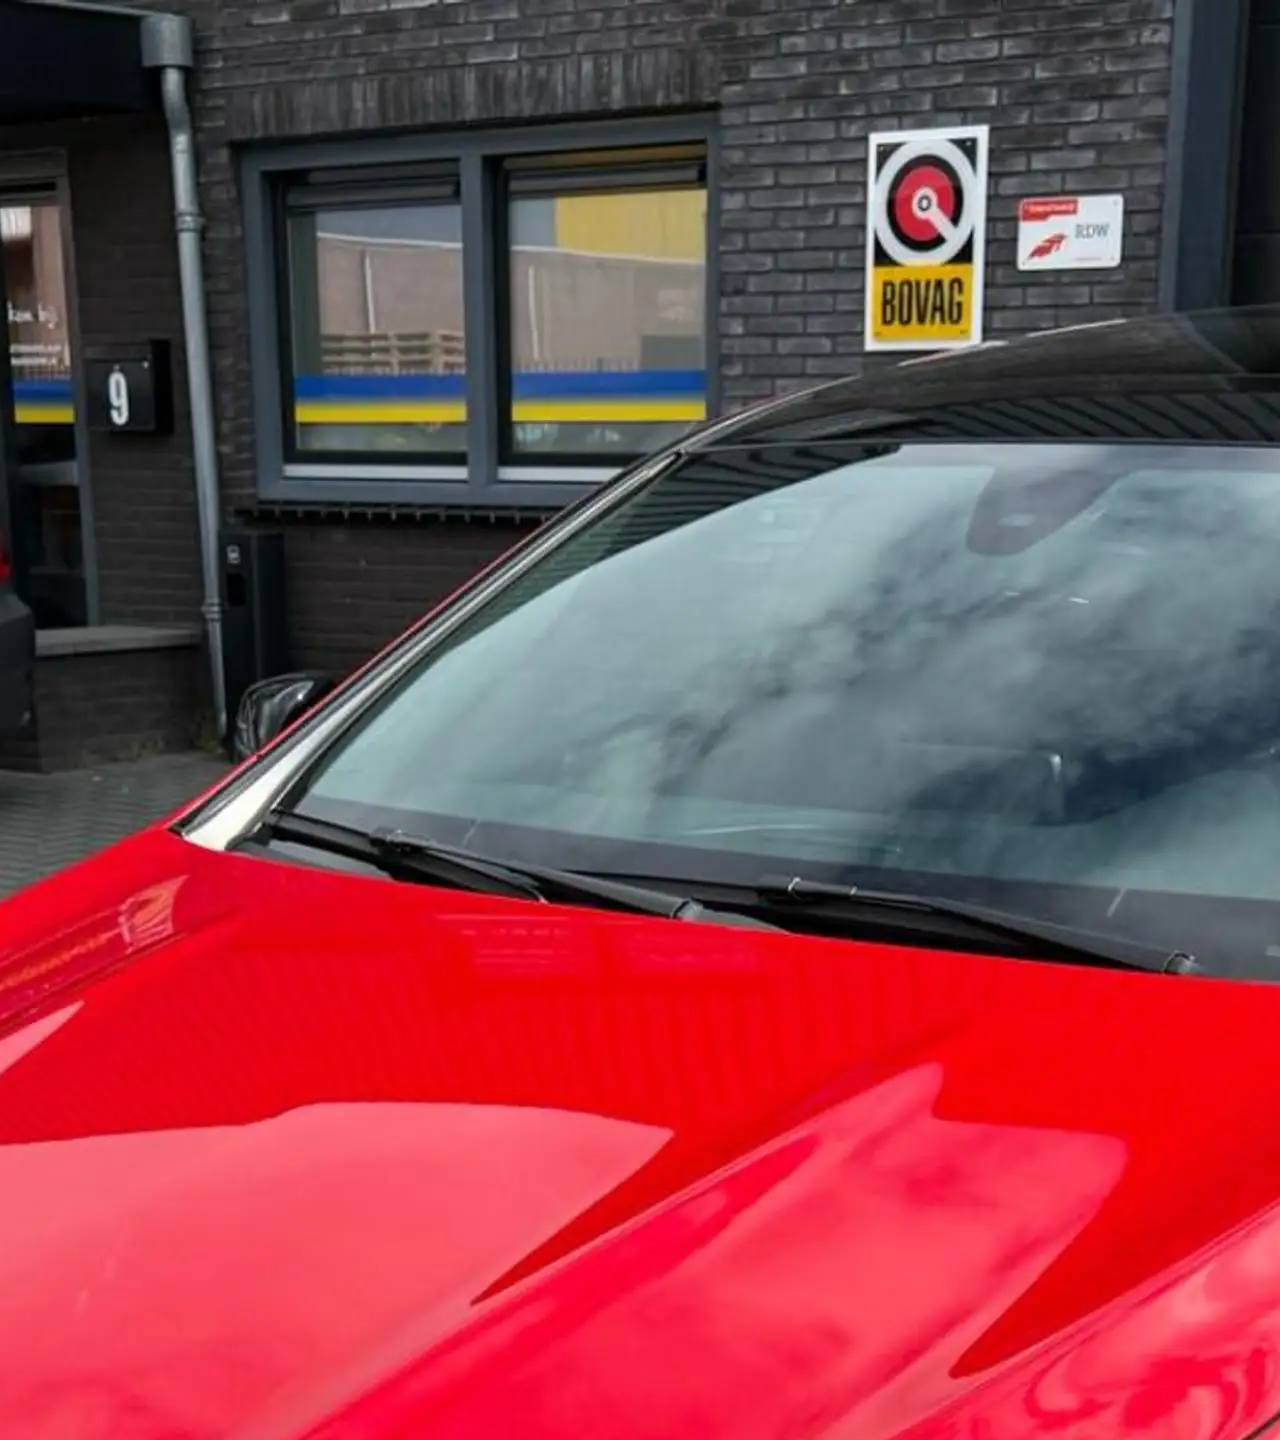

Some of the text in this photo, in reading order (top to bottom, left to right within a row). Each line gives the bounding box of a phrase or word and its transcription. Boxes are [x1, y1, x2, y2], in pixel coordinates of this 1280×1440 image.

[1074, 222, 1110, 240] RDW
[882, 277, 963, 326] BOVAG
[108, 371, 129, 426] 9
